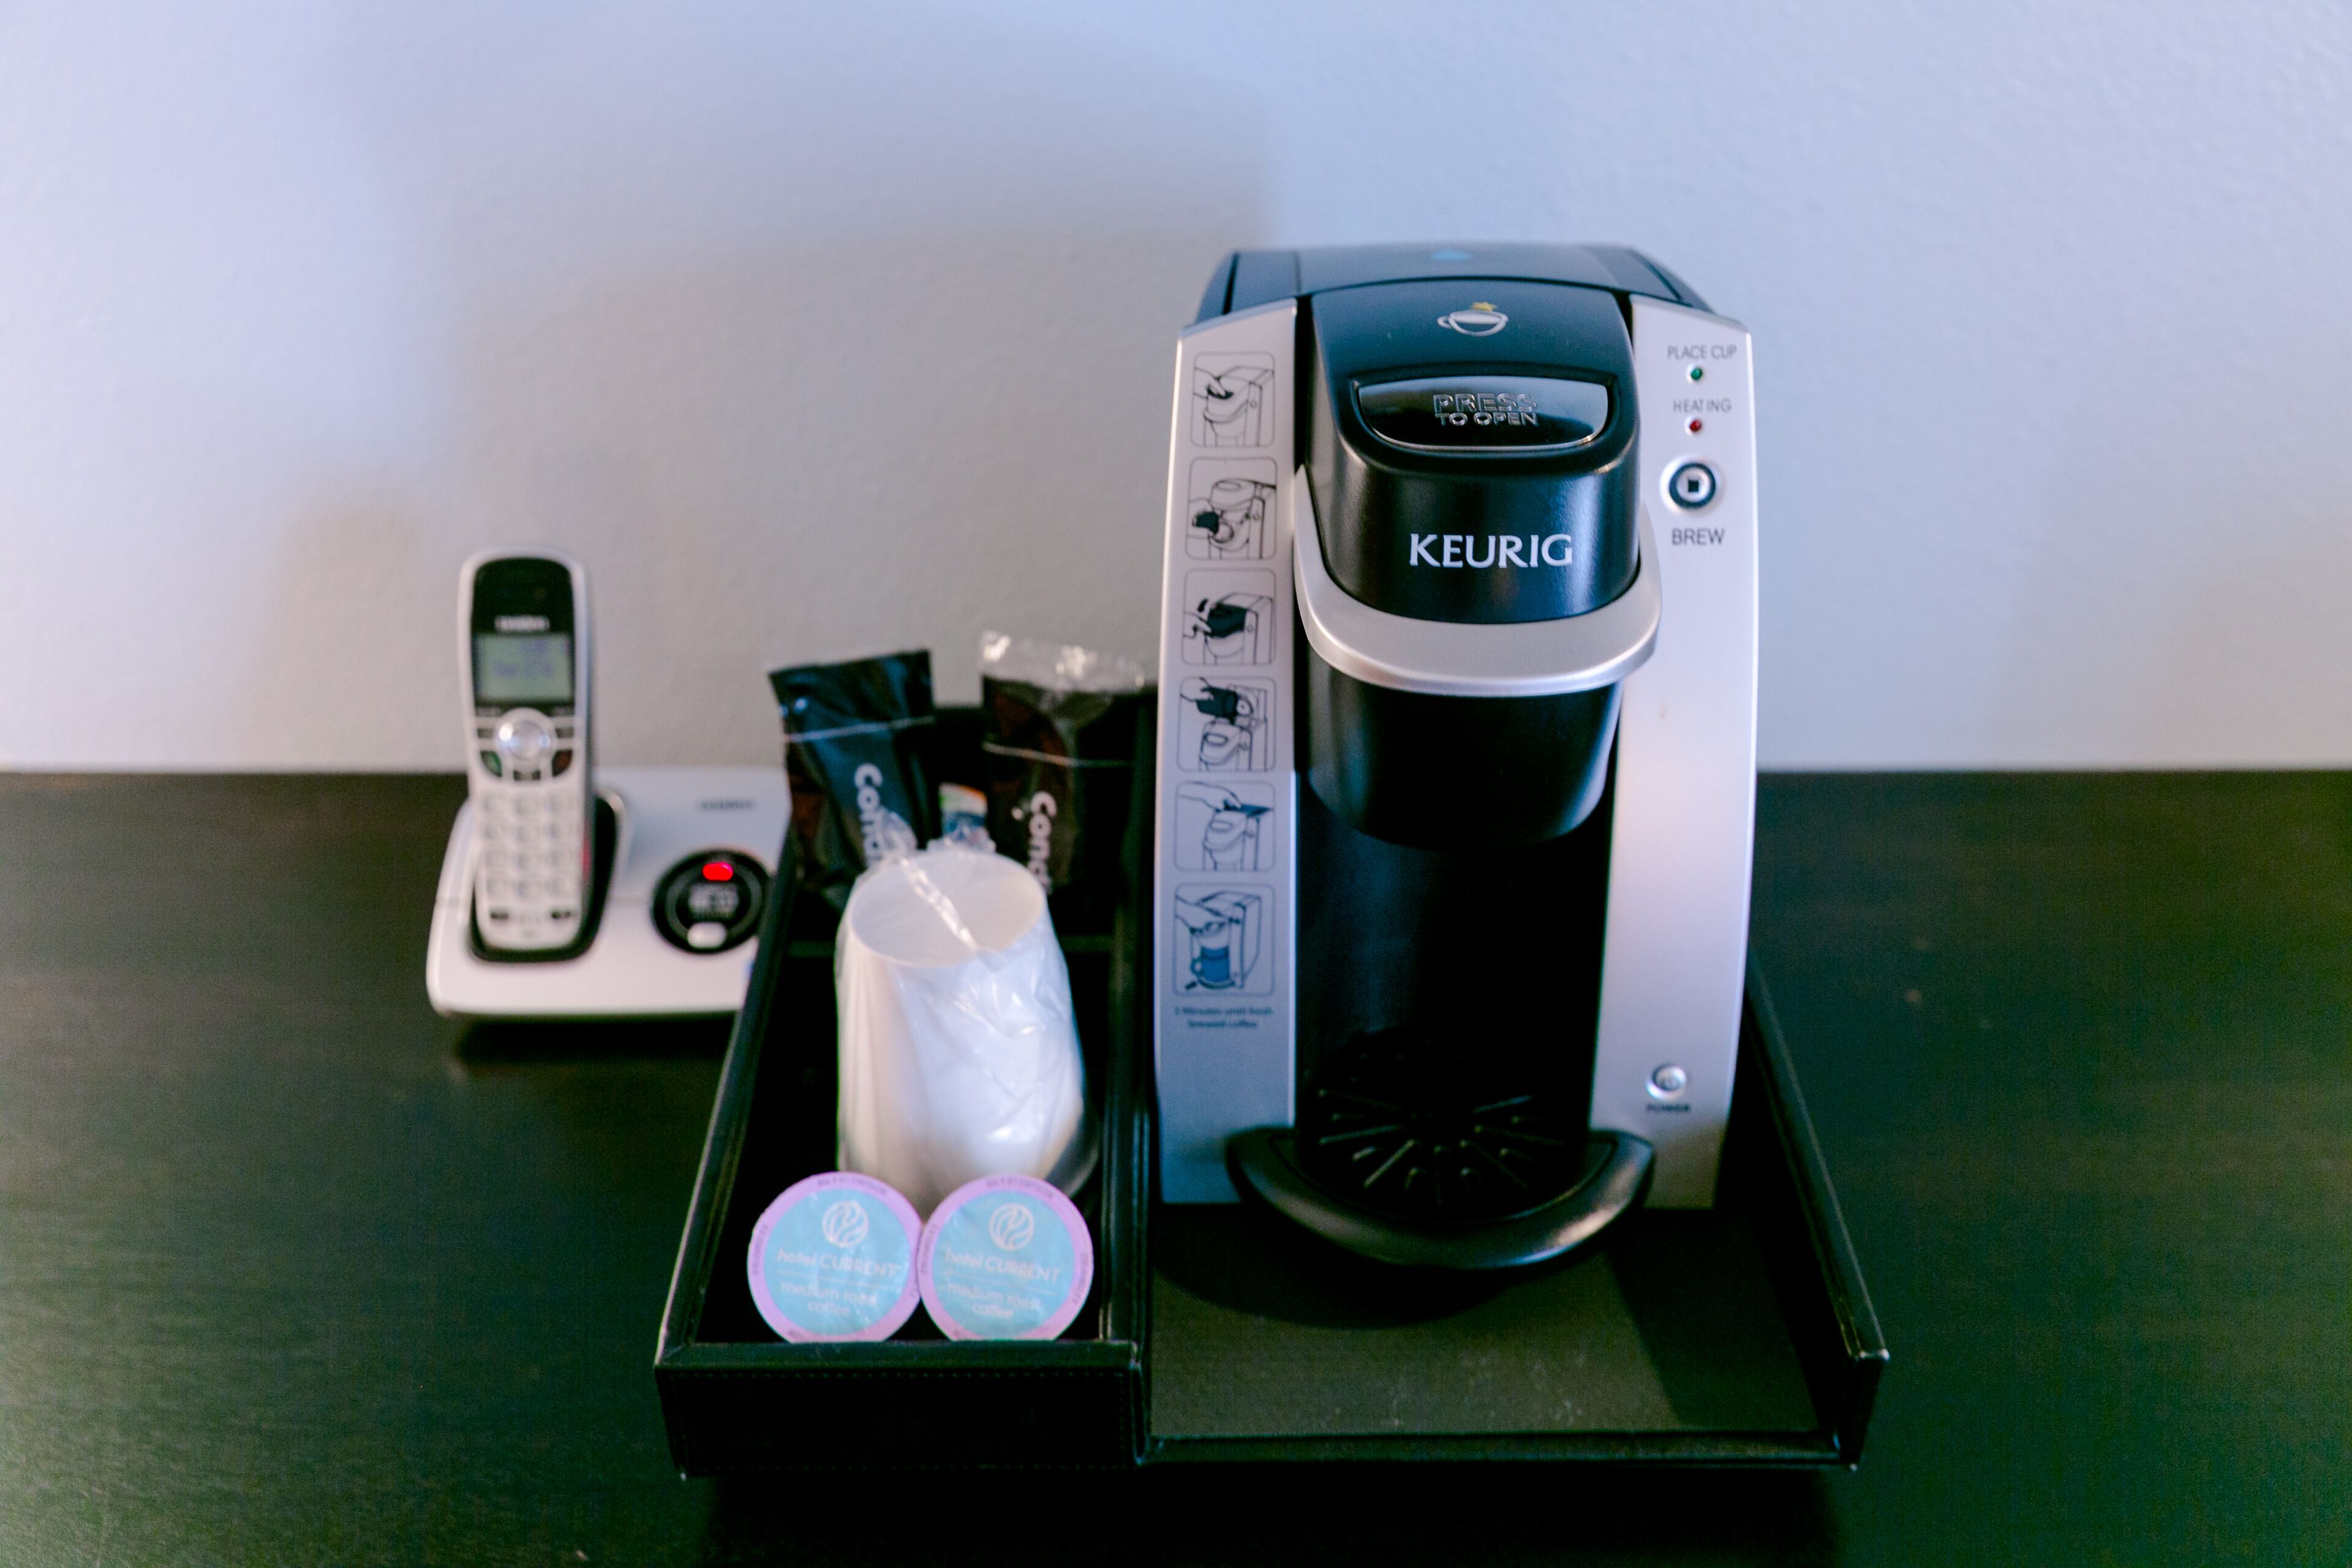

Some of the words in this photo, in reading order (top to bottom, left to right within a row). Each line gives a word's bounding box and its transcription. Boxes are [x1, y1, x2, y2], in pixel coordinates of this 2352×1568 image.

[1667, 344, 1707, 360] PLACE
[1711, 344, 1738, 360] CUP
[1433, 393, 1538, 413] PRESS
[1673, 398, 1732, 413] HEATING
[1434, 412, 1469, 426] TO
[1473, 412, 1539, 427] OPEN
[1672, 527, 1725, 545] BREW
[1409, 533, 1573, 568] KEURIG
[777, 1248, 816, 1266] hotel
[820, 1253, 899, 1278] CURRENT
[945, 1246, 983, 1268] hotel
[986, 1256, 1061, 1283] CURRENT
